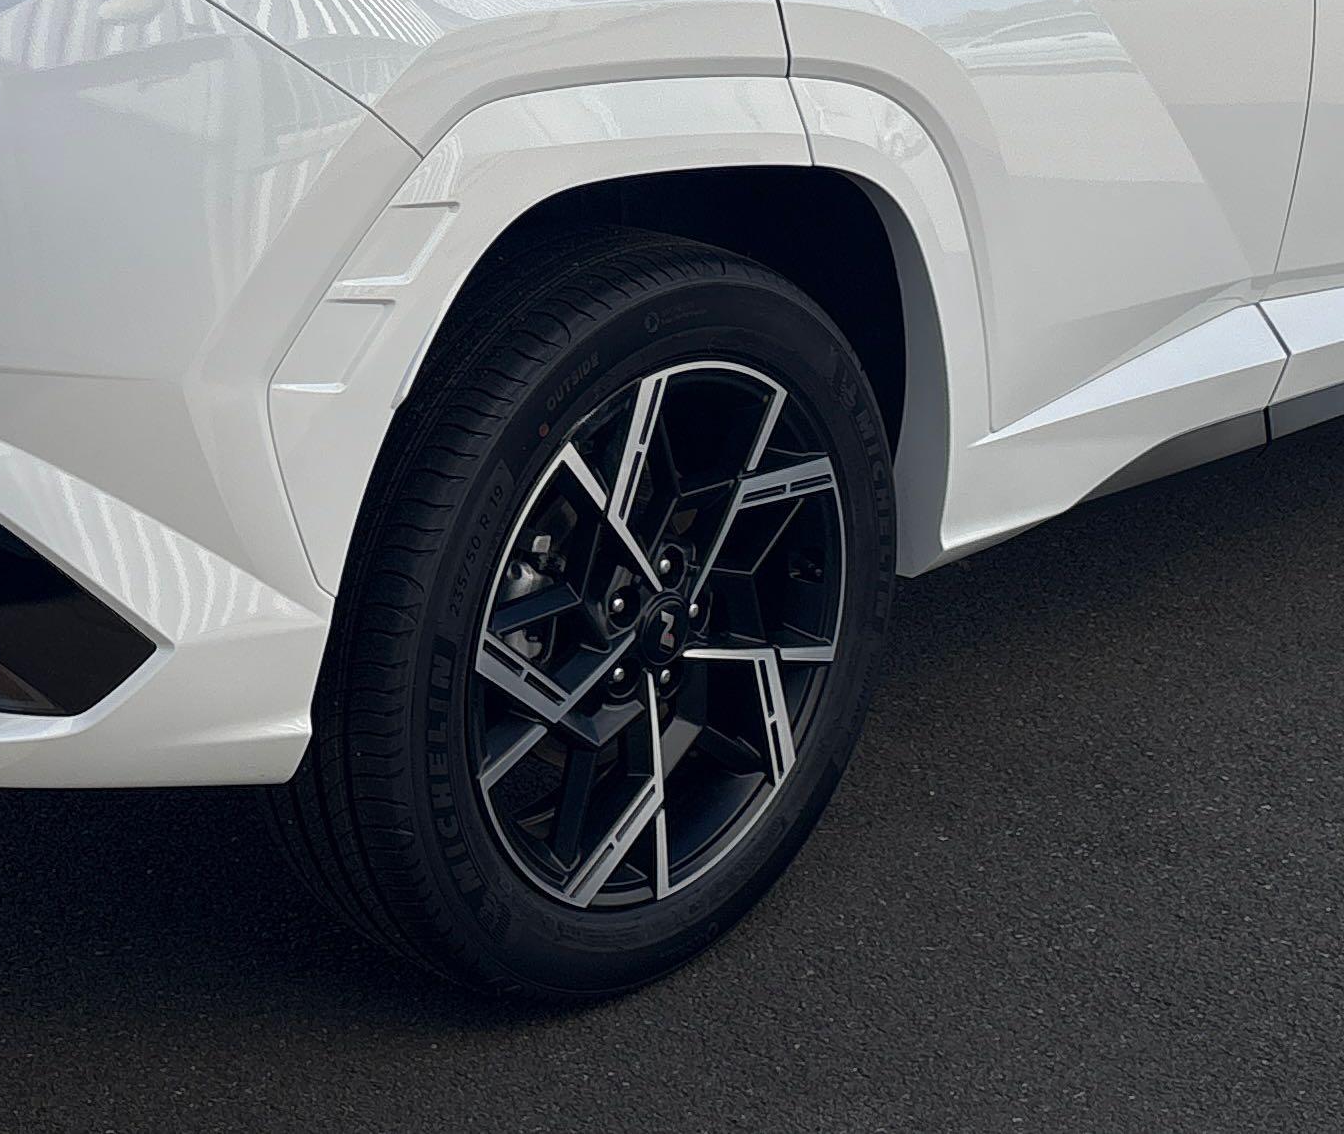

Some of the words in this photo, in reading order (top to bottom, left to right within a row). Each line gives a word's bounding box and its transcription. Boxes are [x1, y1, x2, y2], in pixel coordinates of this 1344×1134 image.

[546, 352, 600, 411] OUTSIDE
[449, 534, 482, 617] 235/50
[479, 515, 491, 531] R
[489, 485, 505, 508] 19
[426, 651, 484, 897] MICHELIN
